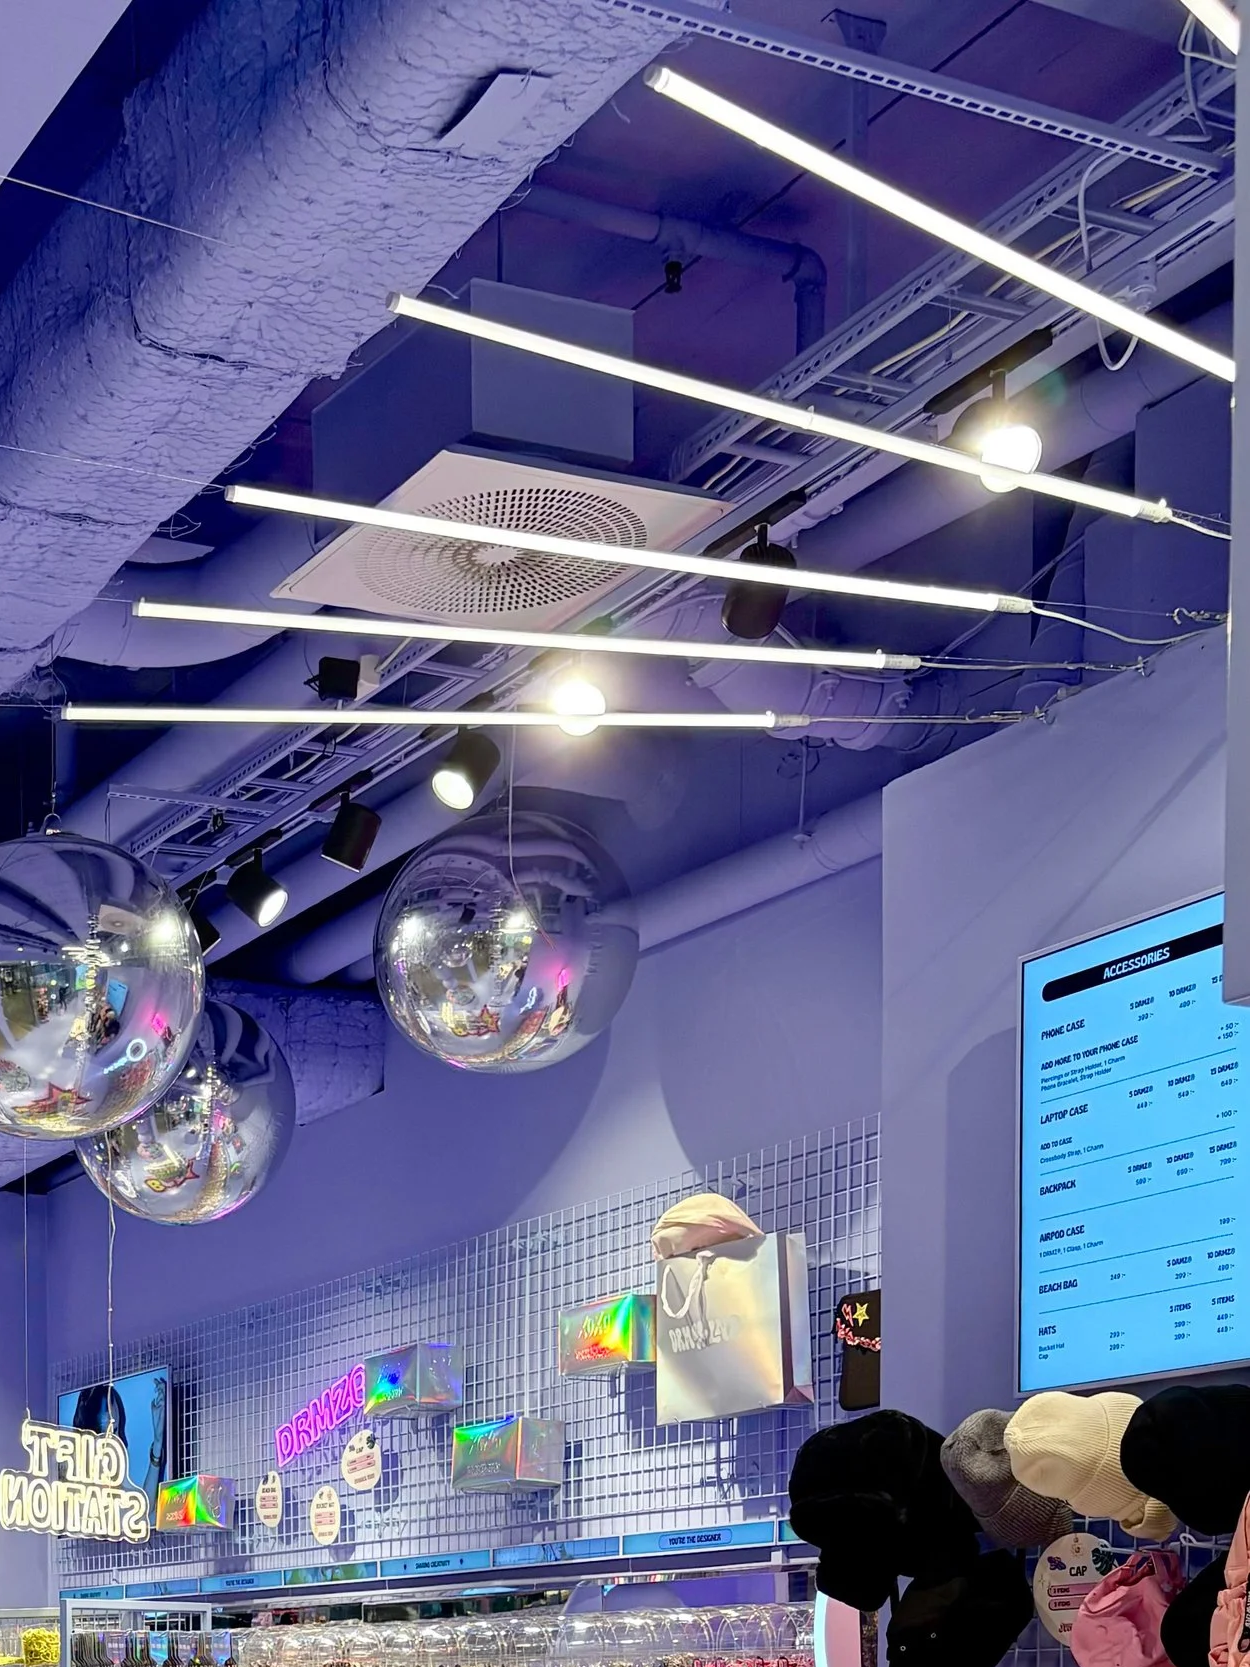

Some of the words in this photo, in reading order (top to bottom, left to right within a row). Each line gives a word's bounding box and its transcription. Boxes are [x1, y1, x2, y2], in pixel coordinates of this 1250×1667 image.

[1104, 947, 1170, 979] ACCESSORIES
[1041, 1025, 1064, 1040] PHONE
[1066, 1019, 1085, 1033] CASE
[1225, 1022, 1233, 1030] 50
[1041, 1061, 1053, 1071] ADD
[1054, 1054, 1071, 1068] MORE
[1073, 1053, 1081, 1061] TO
[1082, 1046, 1098, 1058] YOUR
[1099, 1040, 1120, 1054] PHONE
[1122, 1035, 1139, 1048] CASE
[1070, 1066, 1084, 1076] Strap
[1108, 1055, 1125, 1065] Charm
[1041, 1082, 1056, 1091] Phone
[1080, 1072, 1094, 1084] Strap
[1094, 1067, 1111, 1076] Holder
[1040, 1109, 1068, 1124] LAPTOP
[1069, 1104, 1088, 1118] CASE
[1040, 1142, 1050, 1151] ADD
[1059, 1137, 1072, 1146] CASE
[1040, 1180, 1076, 1196] BACKPACK
[1039, 1228, 1064, 1243] AIRPOD
[1066, 1225, 1085, 1237] CASE
[1039, 1282, 1062, 1294] BEACH
[1063, 1279, 1078, 1289] BAG
[1174, 1303, 1191, 1312] ITEMS
[1217, 1295, 1235, 1305] ITEMS
[1039, 1325, 1056, 1336] HATS
[687, 1535, 696, 1544] THE
[697, 1533, 721, 1543] DESIGNER
[1070, 1566, 1087, 1576] CAP
